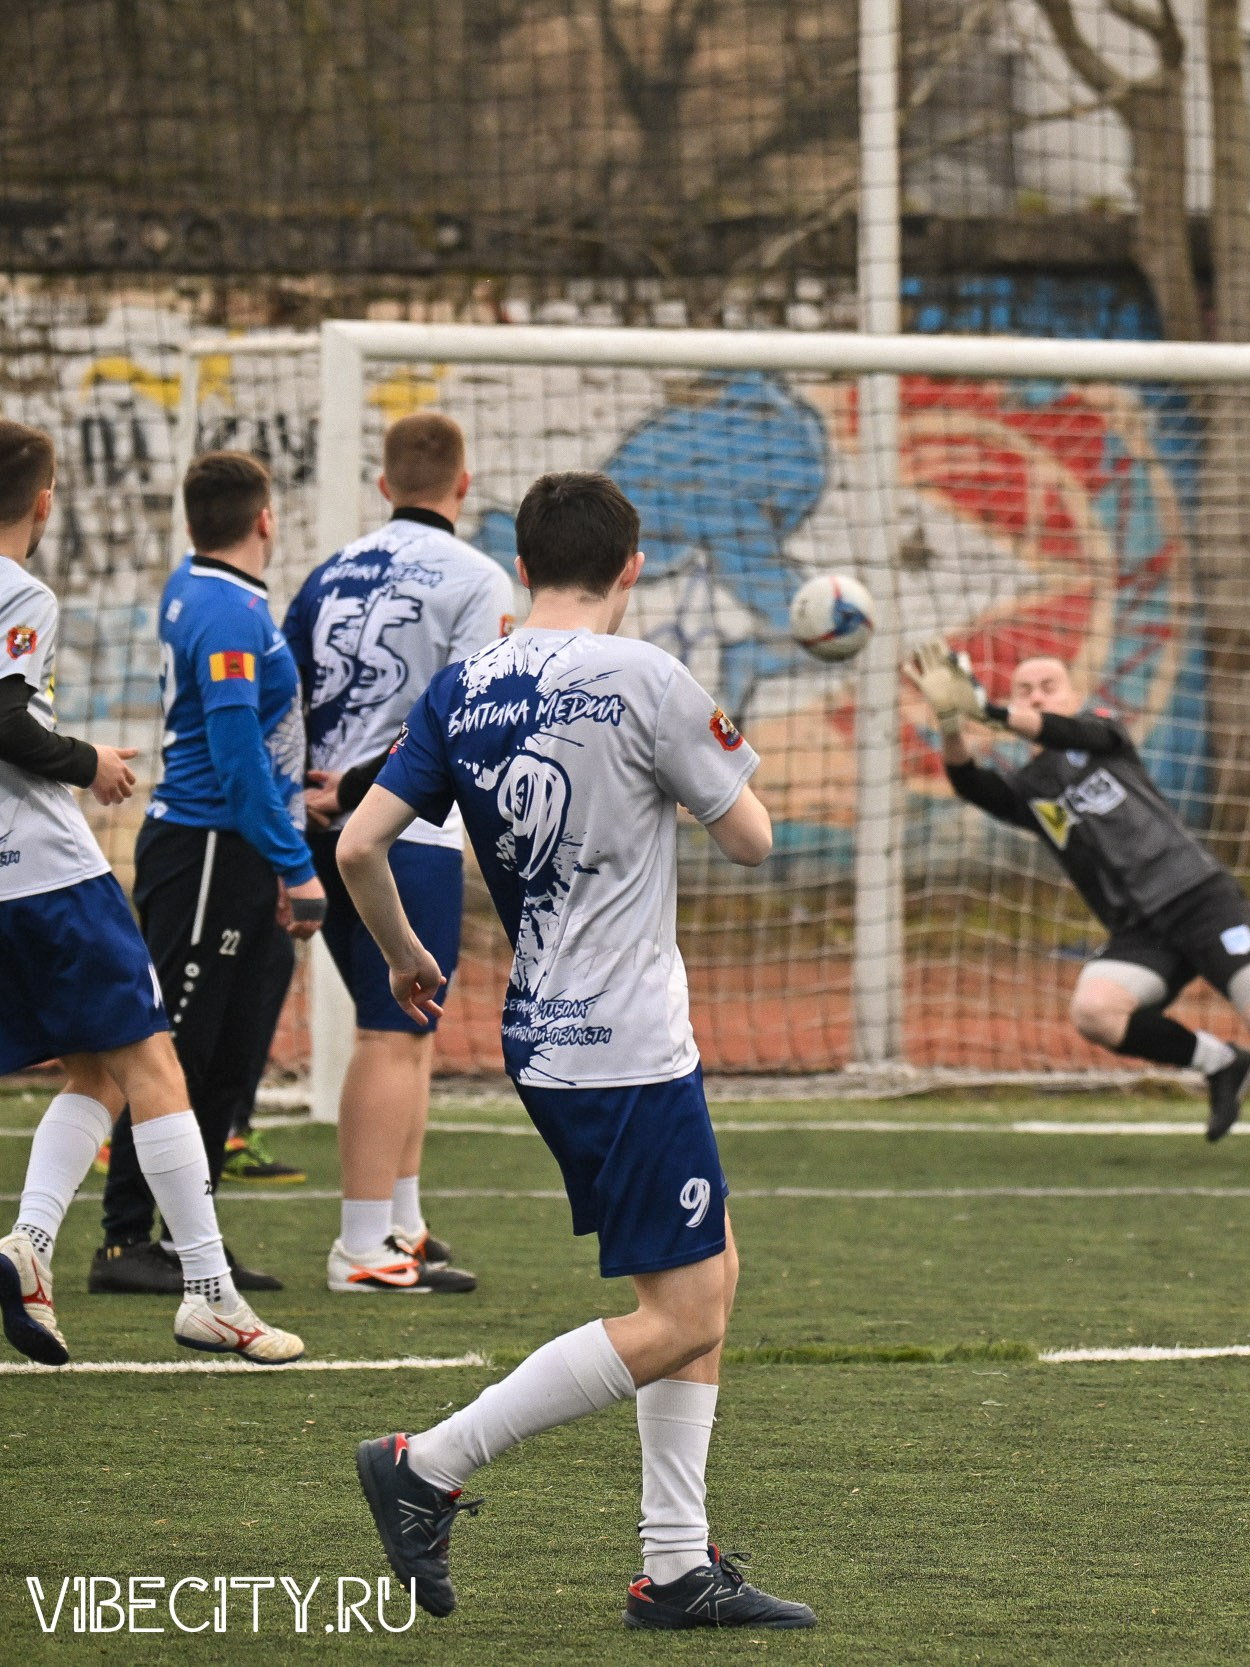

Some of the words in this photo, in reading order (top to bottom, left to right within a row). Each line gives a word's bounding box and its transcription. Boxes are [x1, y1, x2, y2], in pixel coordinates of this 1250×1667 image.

[310, 584, 422, 710] 55
[496, 749, 572, 881] 9
[219, 928, 241, 956] 22
[680, 1177, 710, 1228] 9
